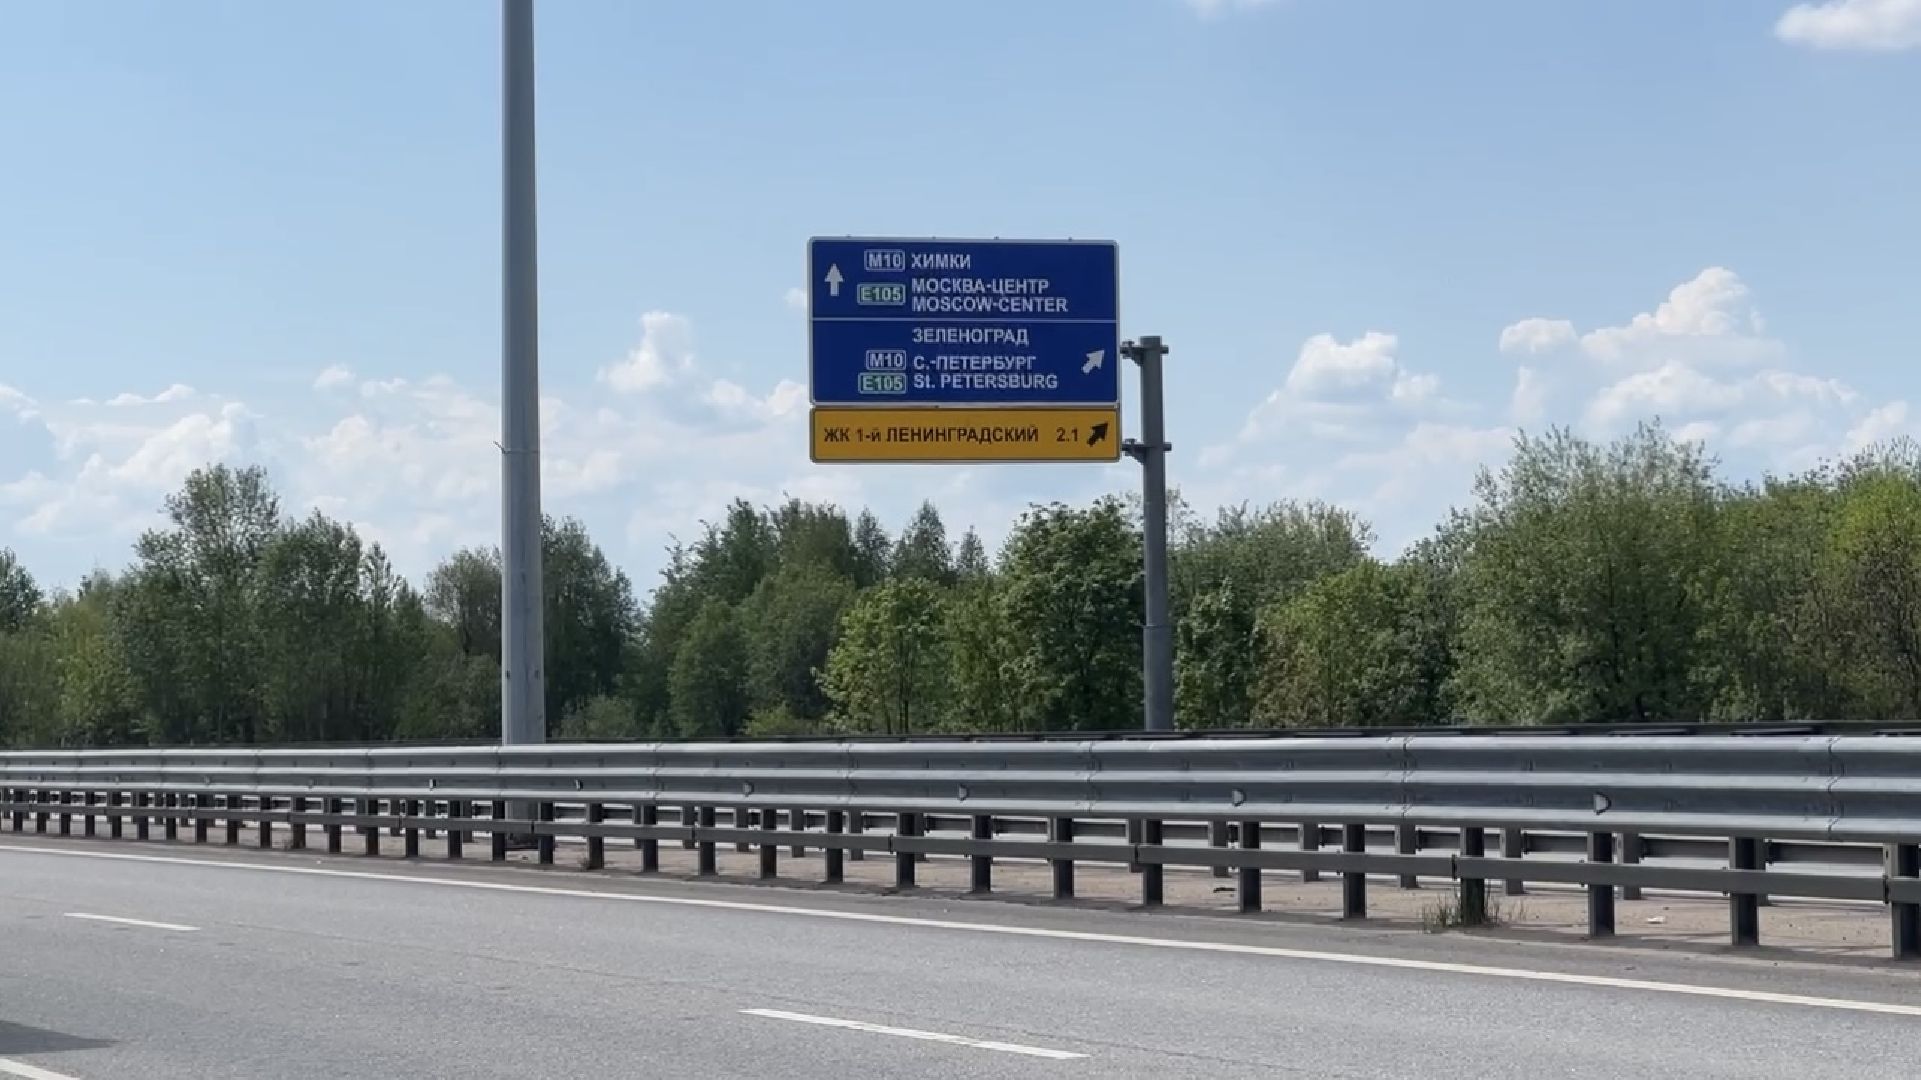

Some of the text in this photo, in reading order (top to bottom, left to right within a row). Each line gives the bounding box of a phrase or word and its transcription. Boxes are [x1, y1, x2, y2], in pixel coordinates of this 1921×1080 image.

[911, 254, 971, 268] ХИМКИ
[912, 278, 1049, 295] МОСКВА-ЦЕНТР
[912, 297, 1068, 312] MOSCOW-CENTER
[912, 328, 1028, 346] ЗЕЛЕНОГРАД
[914, 356, 1036, 371] С.-ПЕТЕРБУРГ
[914, 374, 1057, 389] St. PETERSBURG
[824, 425, 1079, 444] ЖК 1-й ЛЕНИНГРАДСКИЙ 2.1
